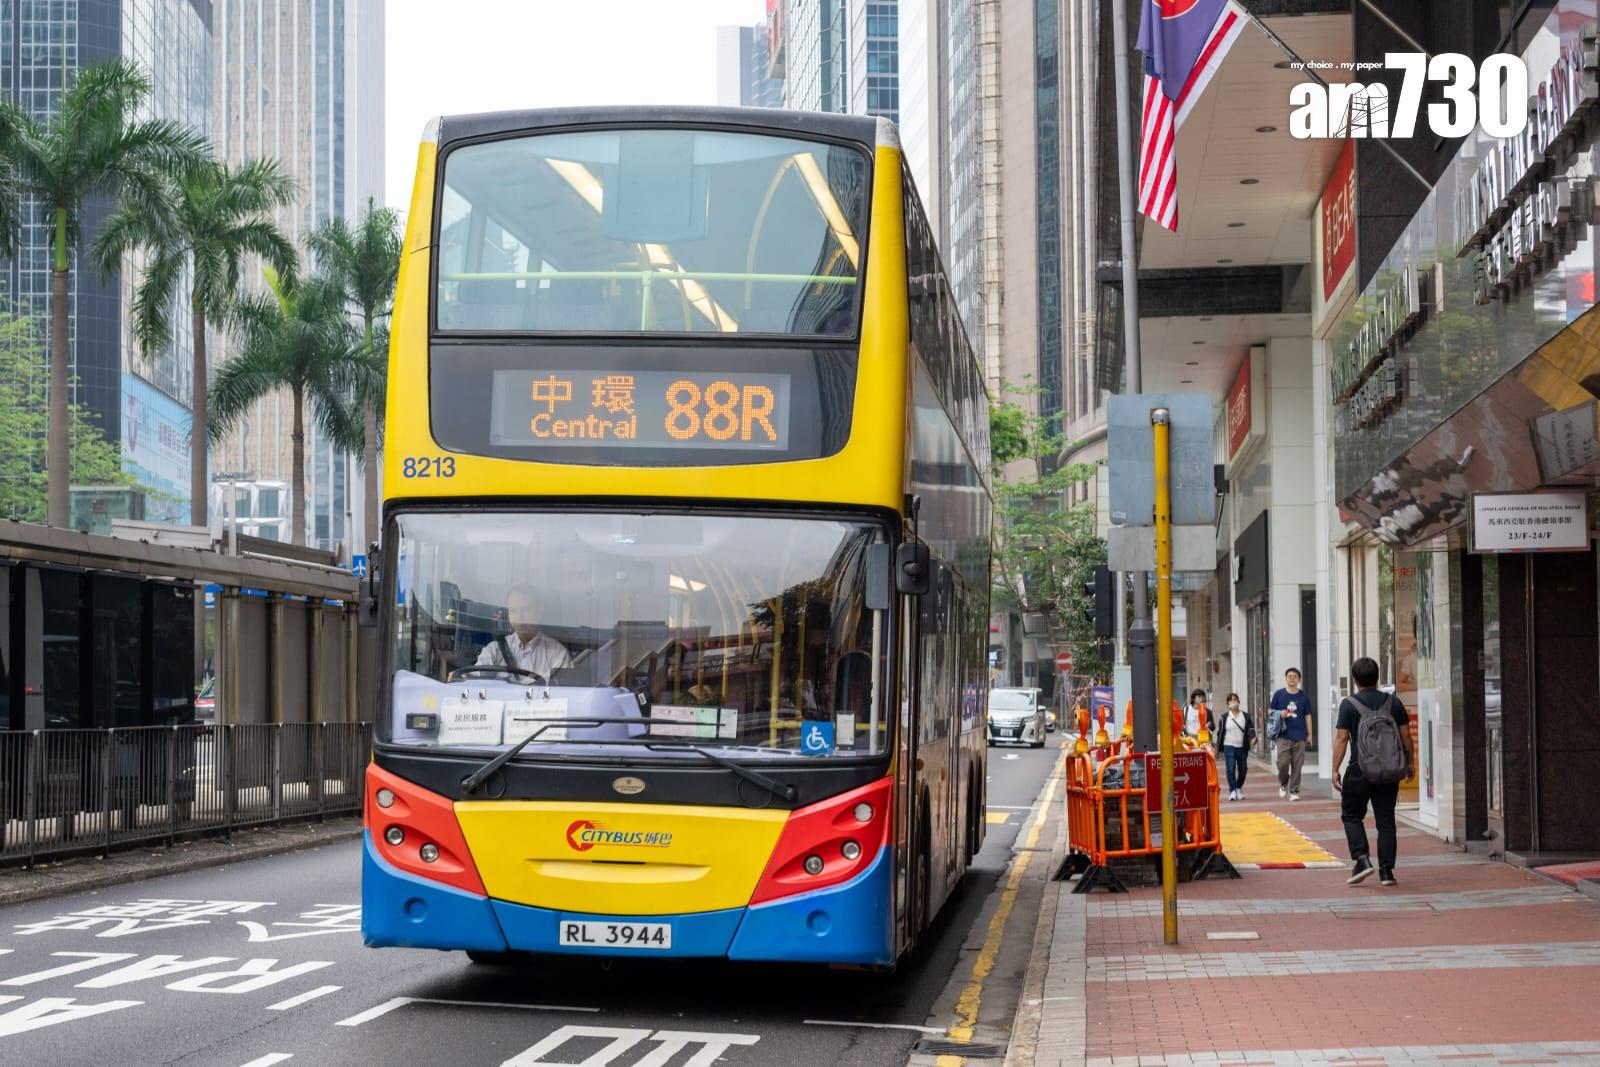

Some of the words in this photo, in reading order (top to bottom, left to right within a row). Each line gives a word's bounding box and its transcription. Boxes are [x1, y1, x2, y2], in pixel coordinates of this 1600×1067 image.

[532, 375, 635, 413] 中環
[664, 379, 777, 441] 88R
[531, 413, 637, 440] Central
[403, 456, 455, 478] 8213
[1508, 531, 1552, 541] 23/F-24/F
[1151, 755, 1204, 769] PESTRIANS
[581, 829, 643, 843] CITYBUS
[566, 924, 595, 942] RL
[605, 925, 665, 945] 3944
